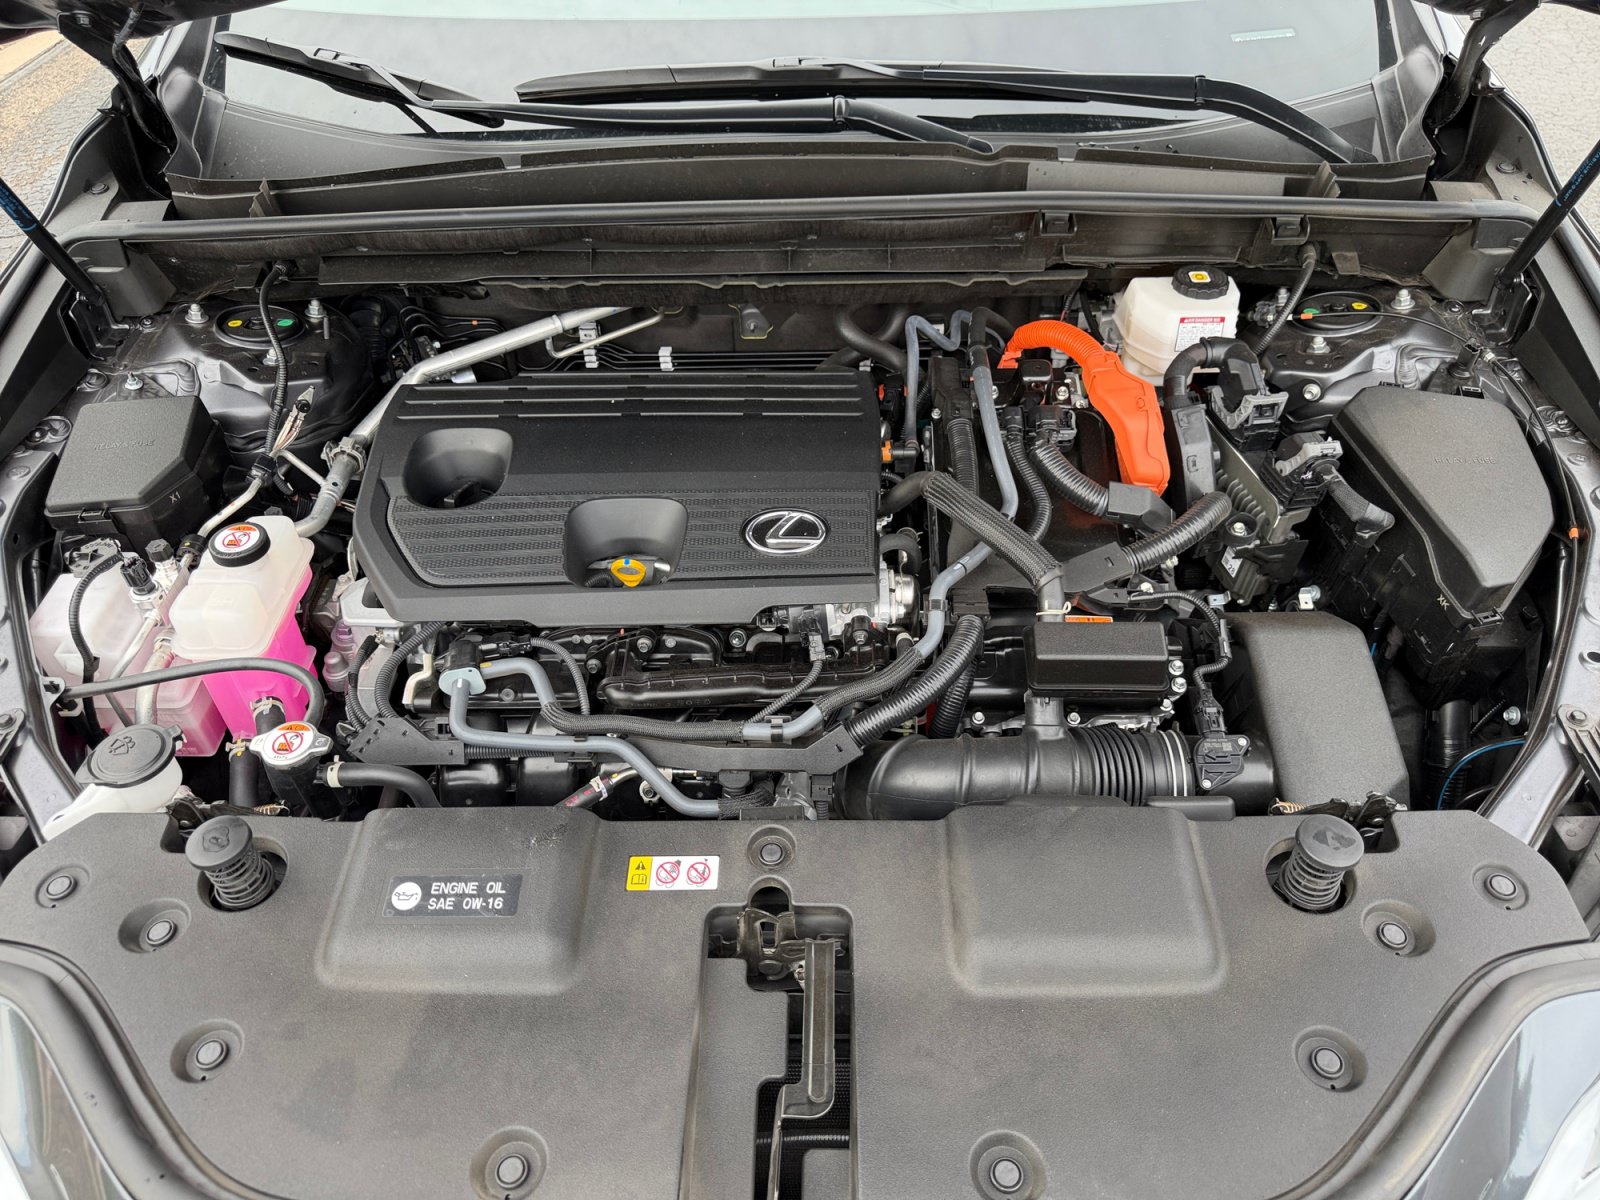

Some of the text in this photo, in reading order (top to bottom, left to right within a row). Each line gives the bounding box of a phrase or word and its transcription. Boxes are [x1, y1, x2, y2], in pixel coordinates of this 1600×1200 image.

[1436, 593, 1450, 612] XK
[430, 881, 507, 895] ENGINE OIL
[427, 897, 505, 910] SAE 0W-16
